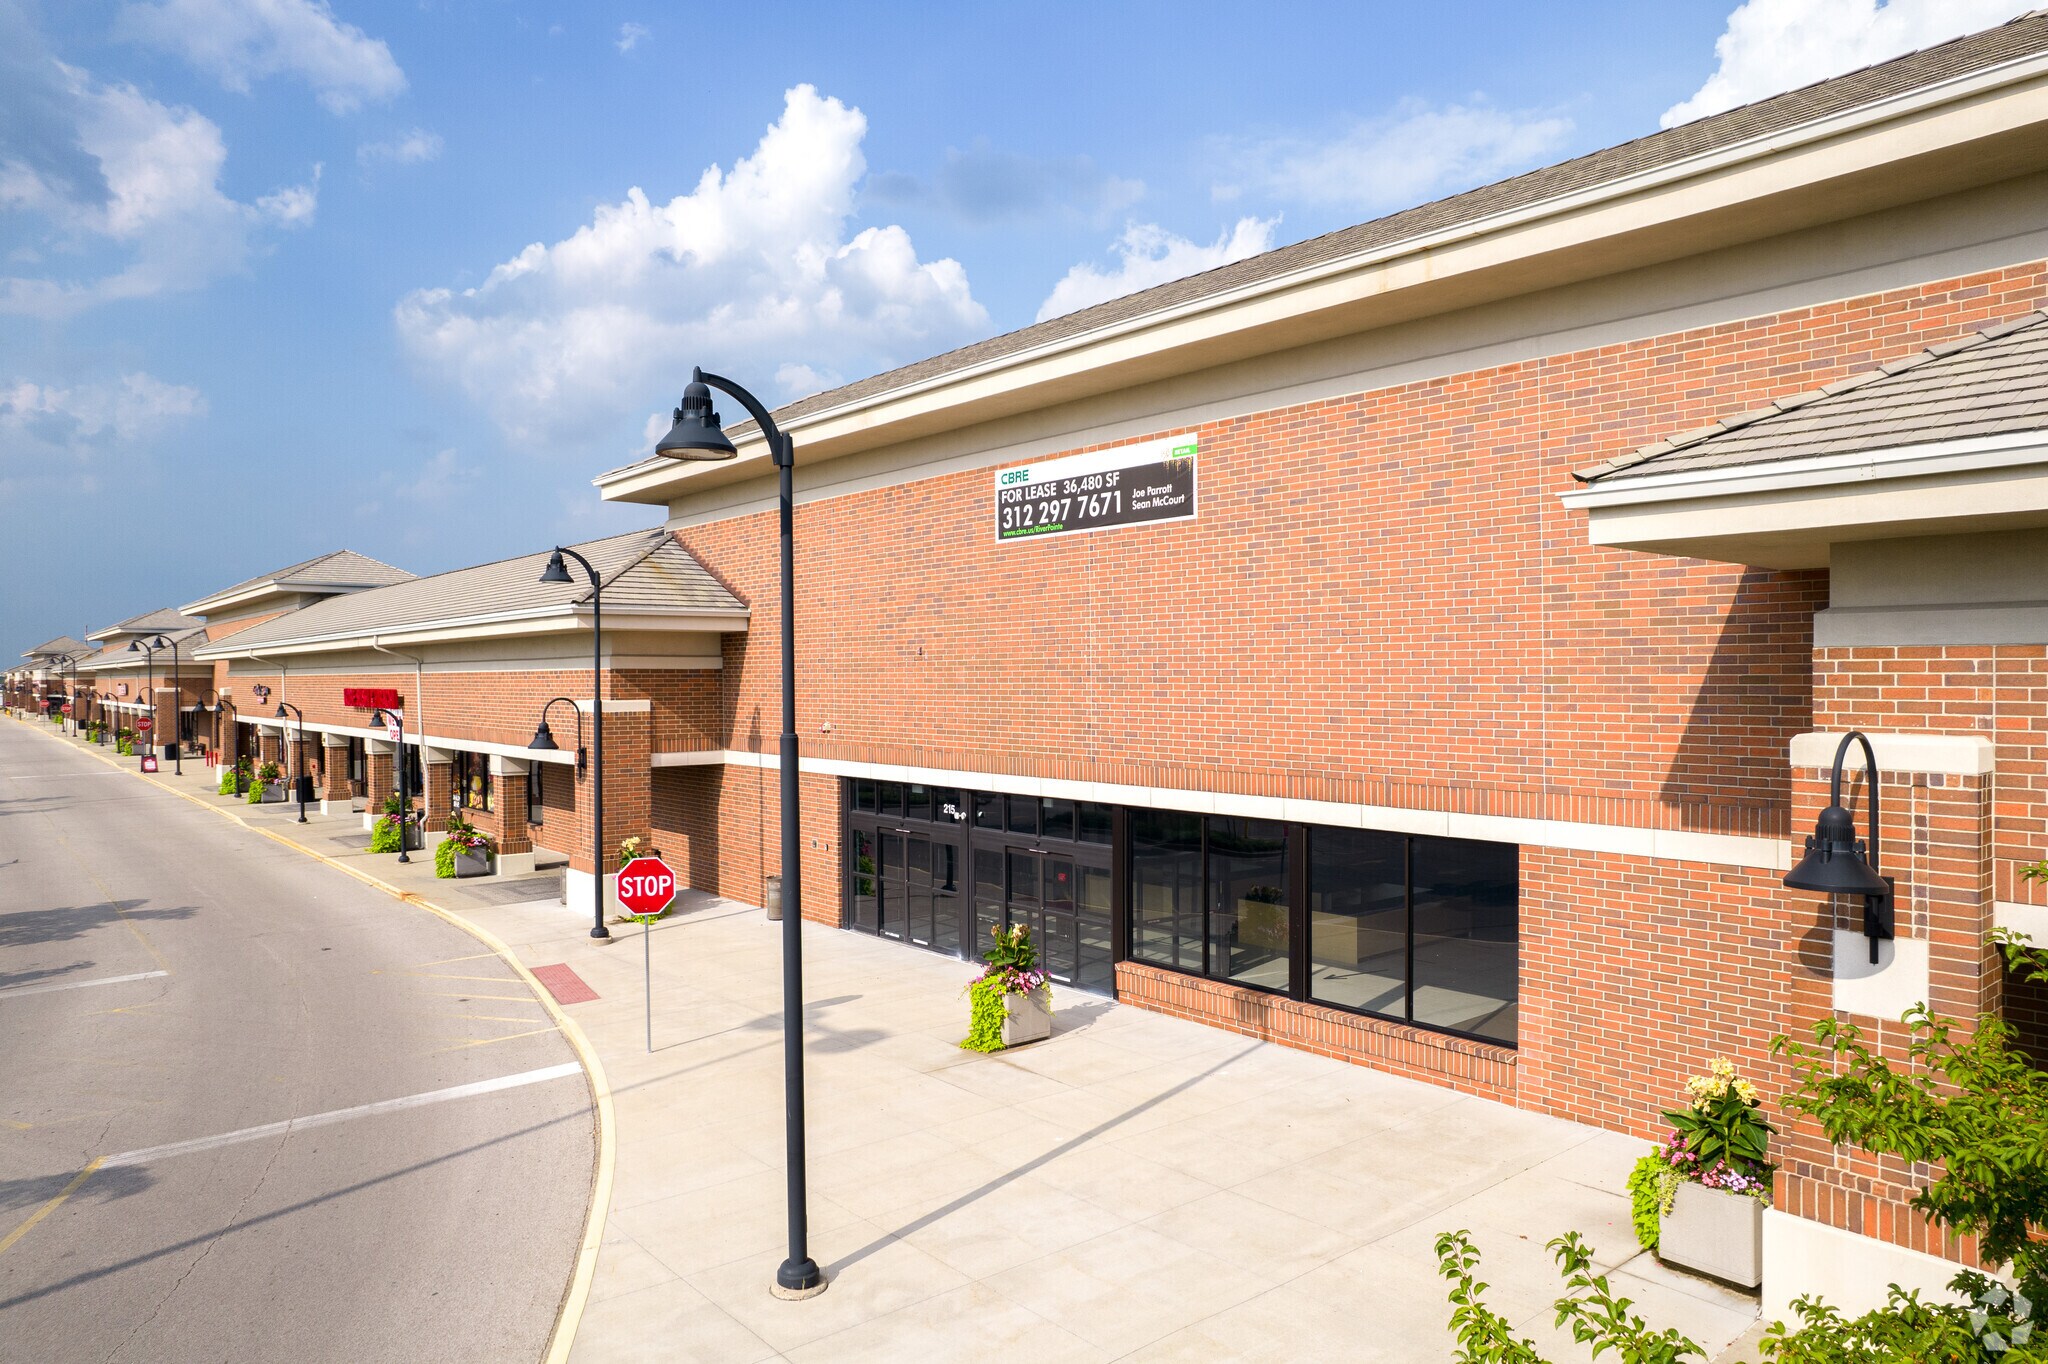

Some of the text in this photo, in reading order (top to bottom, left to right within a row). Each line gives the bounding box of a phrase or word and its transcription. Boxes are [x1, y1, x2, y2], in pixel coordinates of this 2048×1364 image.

[1001, 469, 1029, 485] CBRE
[1001, 471, 1120, 504] FOR LEASE 36,480 SF
[1132, 483, 1173, 499] Joe Parrott
[1002, 490, 1121, 529] 312 297 7671
[1132, 493, 1185, 510] Sean McCourt
[943, 803, 955, 815] 215
[621, 875, 671, 898] STOP
